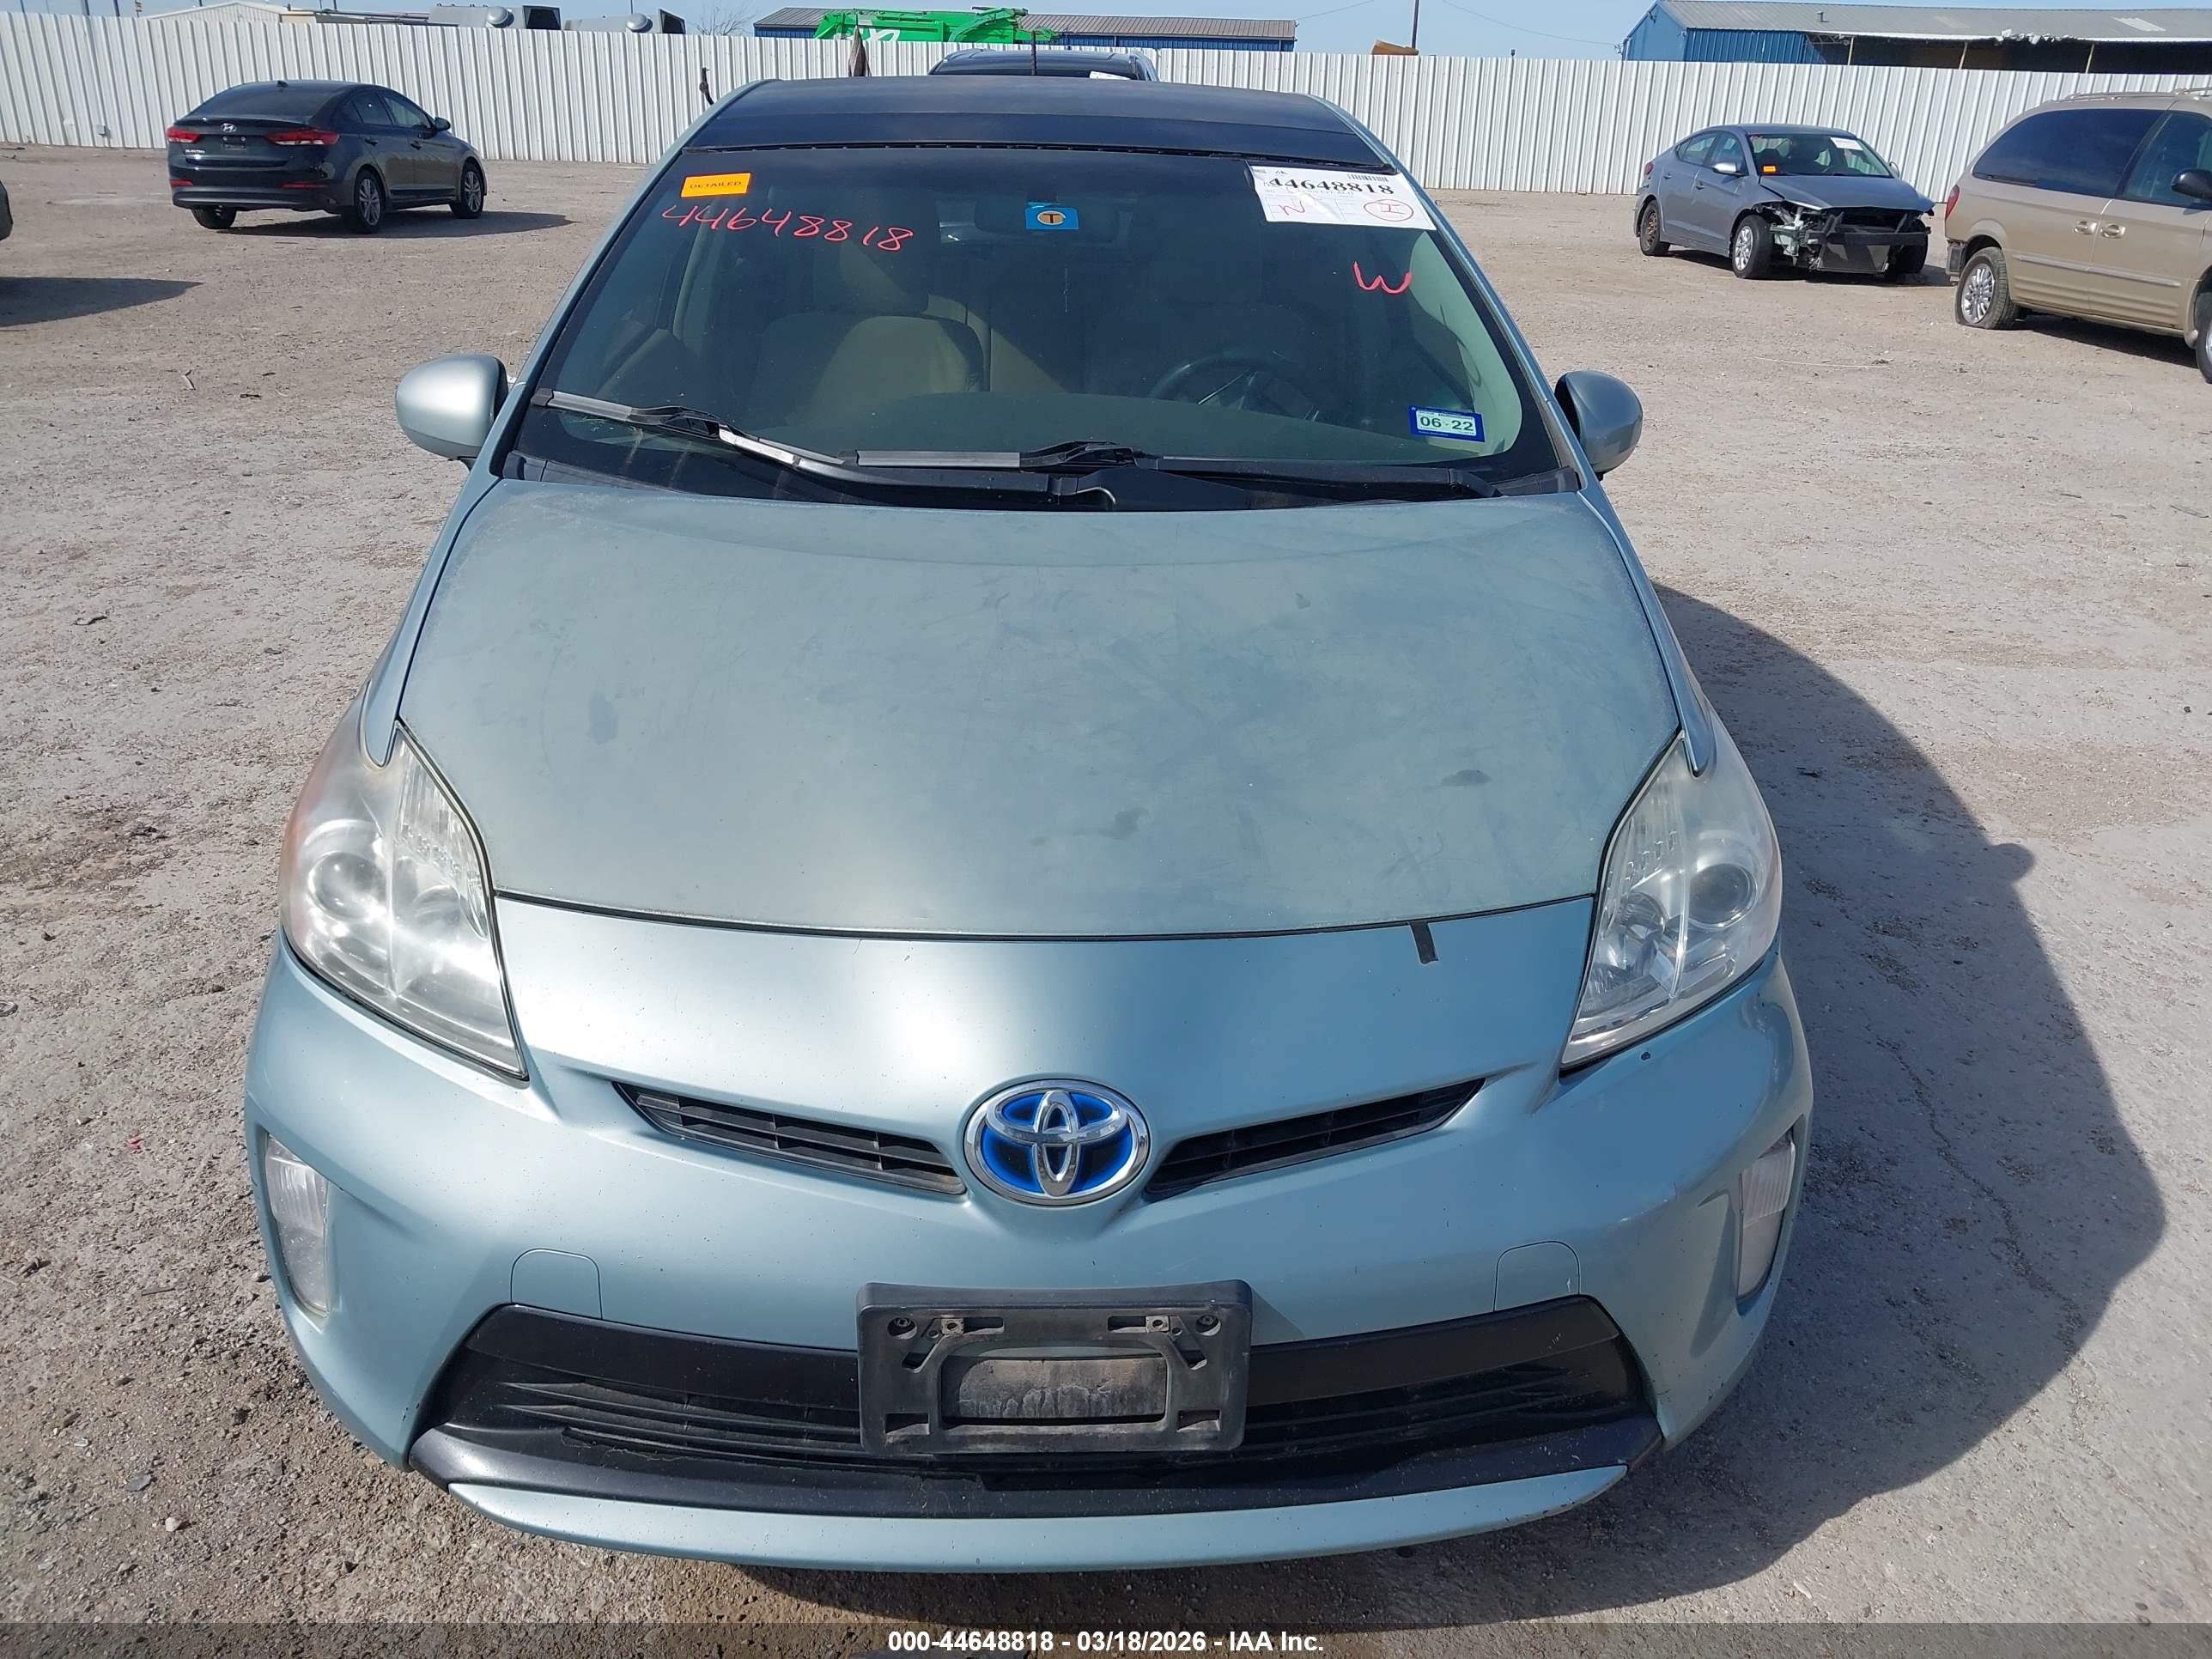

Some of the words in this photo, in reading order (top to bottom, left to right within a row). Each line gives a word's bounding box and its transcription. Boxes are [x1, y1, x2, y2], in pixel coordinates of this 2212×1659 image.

[689, 179, 743, 189] DETAILED
[1268, 177, 1395, 196] 44648818
[661, 204, 914, 251] 44648818
[1352, 261, 1413, 295] W
[1420, 416, 1442, 428] 06
[1451, 420, 1474, 431] 22
